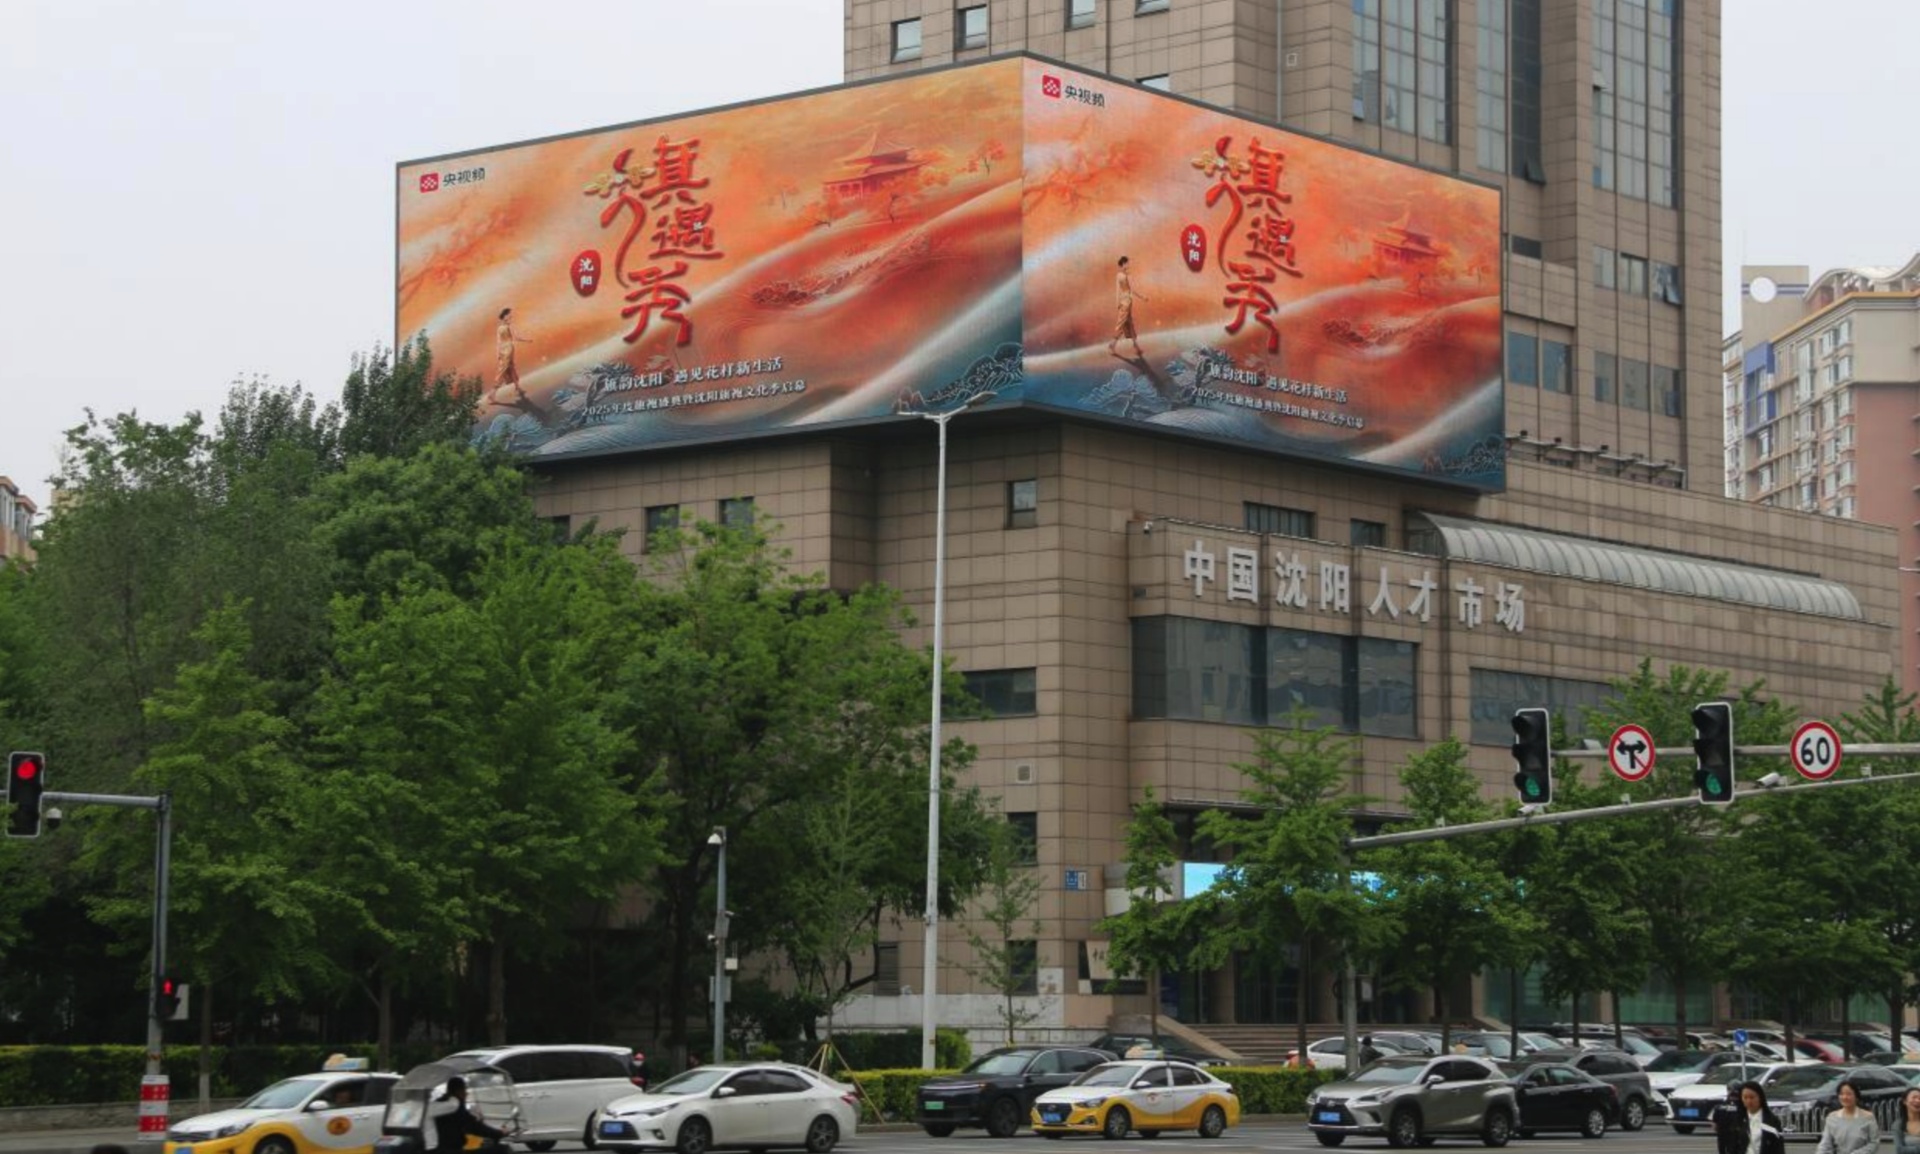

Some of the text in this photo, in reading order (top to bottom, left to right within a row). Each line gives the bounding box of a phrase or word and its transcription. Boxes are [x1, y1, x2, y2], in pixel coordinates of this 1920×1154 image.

[1065, 85, 1105, 108] 央视频
[443, 167, 486, 187] 央视频
[1187, 231, 1201, 262] 沈阳
[579, 257, 595, 289] 沈阳
[603, 371, 663, 392] 旗韵沈阳
[1184, 540, 1526, 632] 中国沈阳人才市场
[1800, 736, 1831, 766] 60
